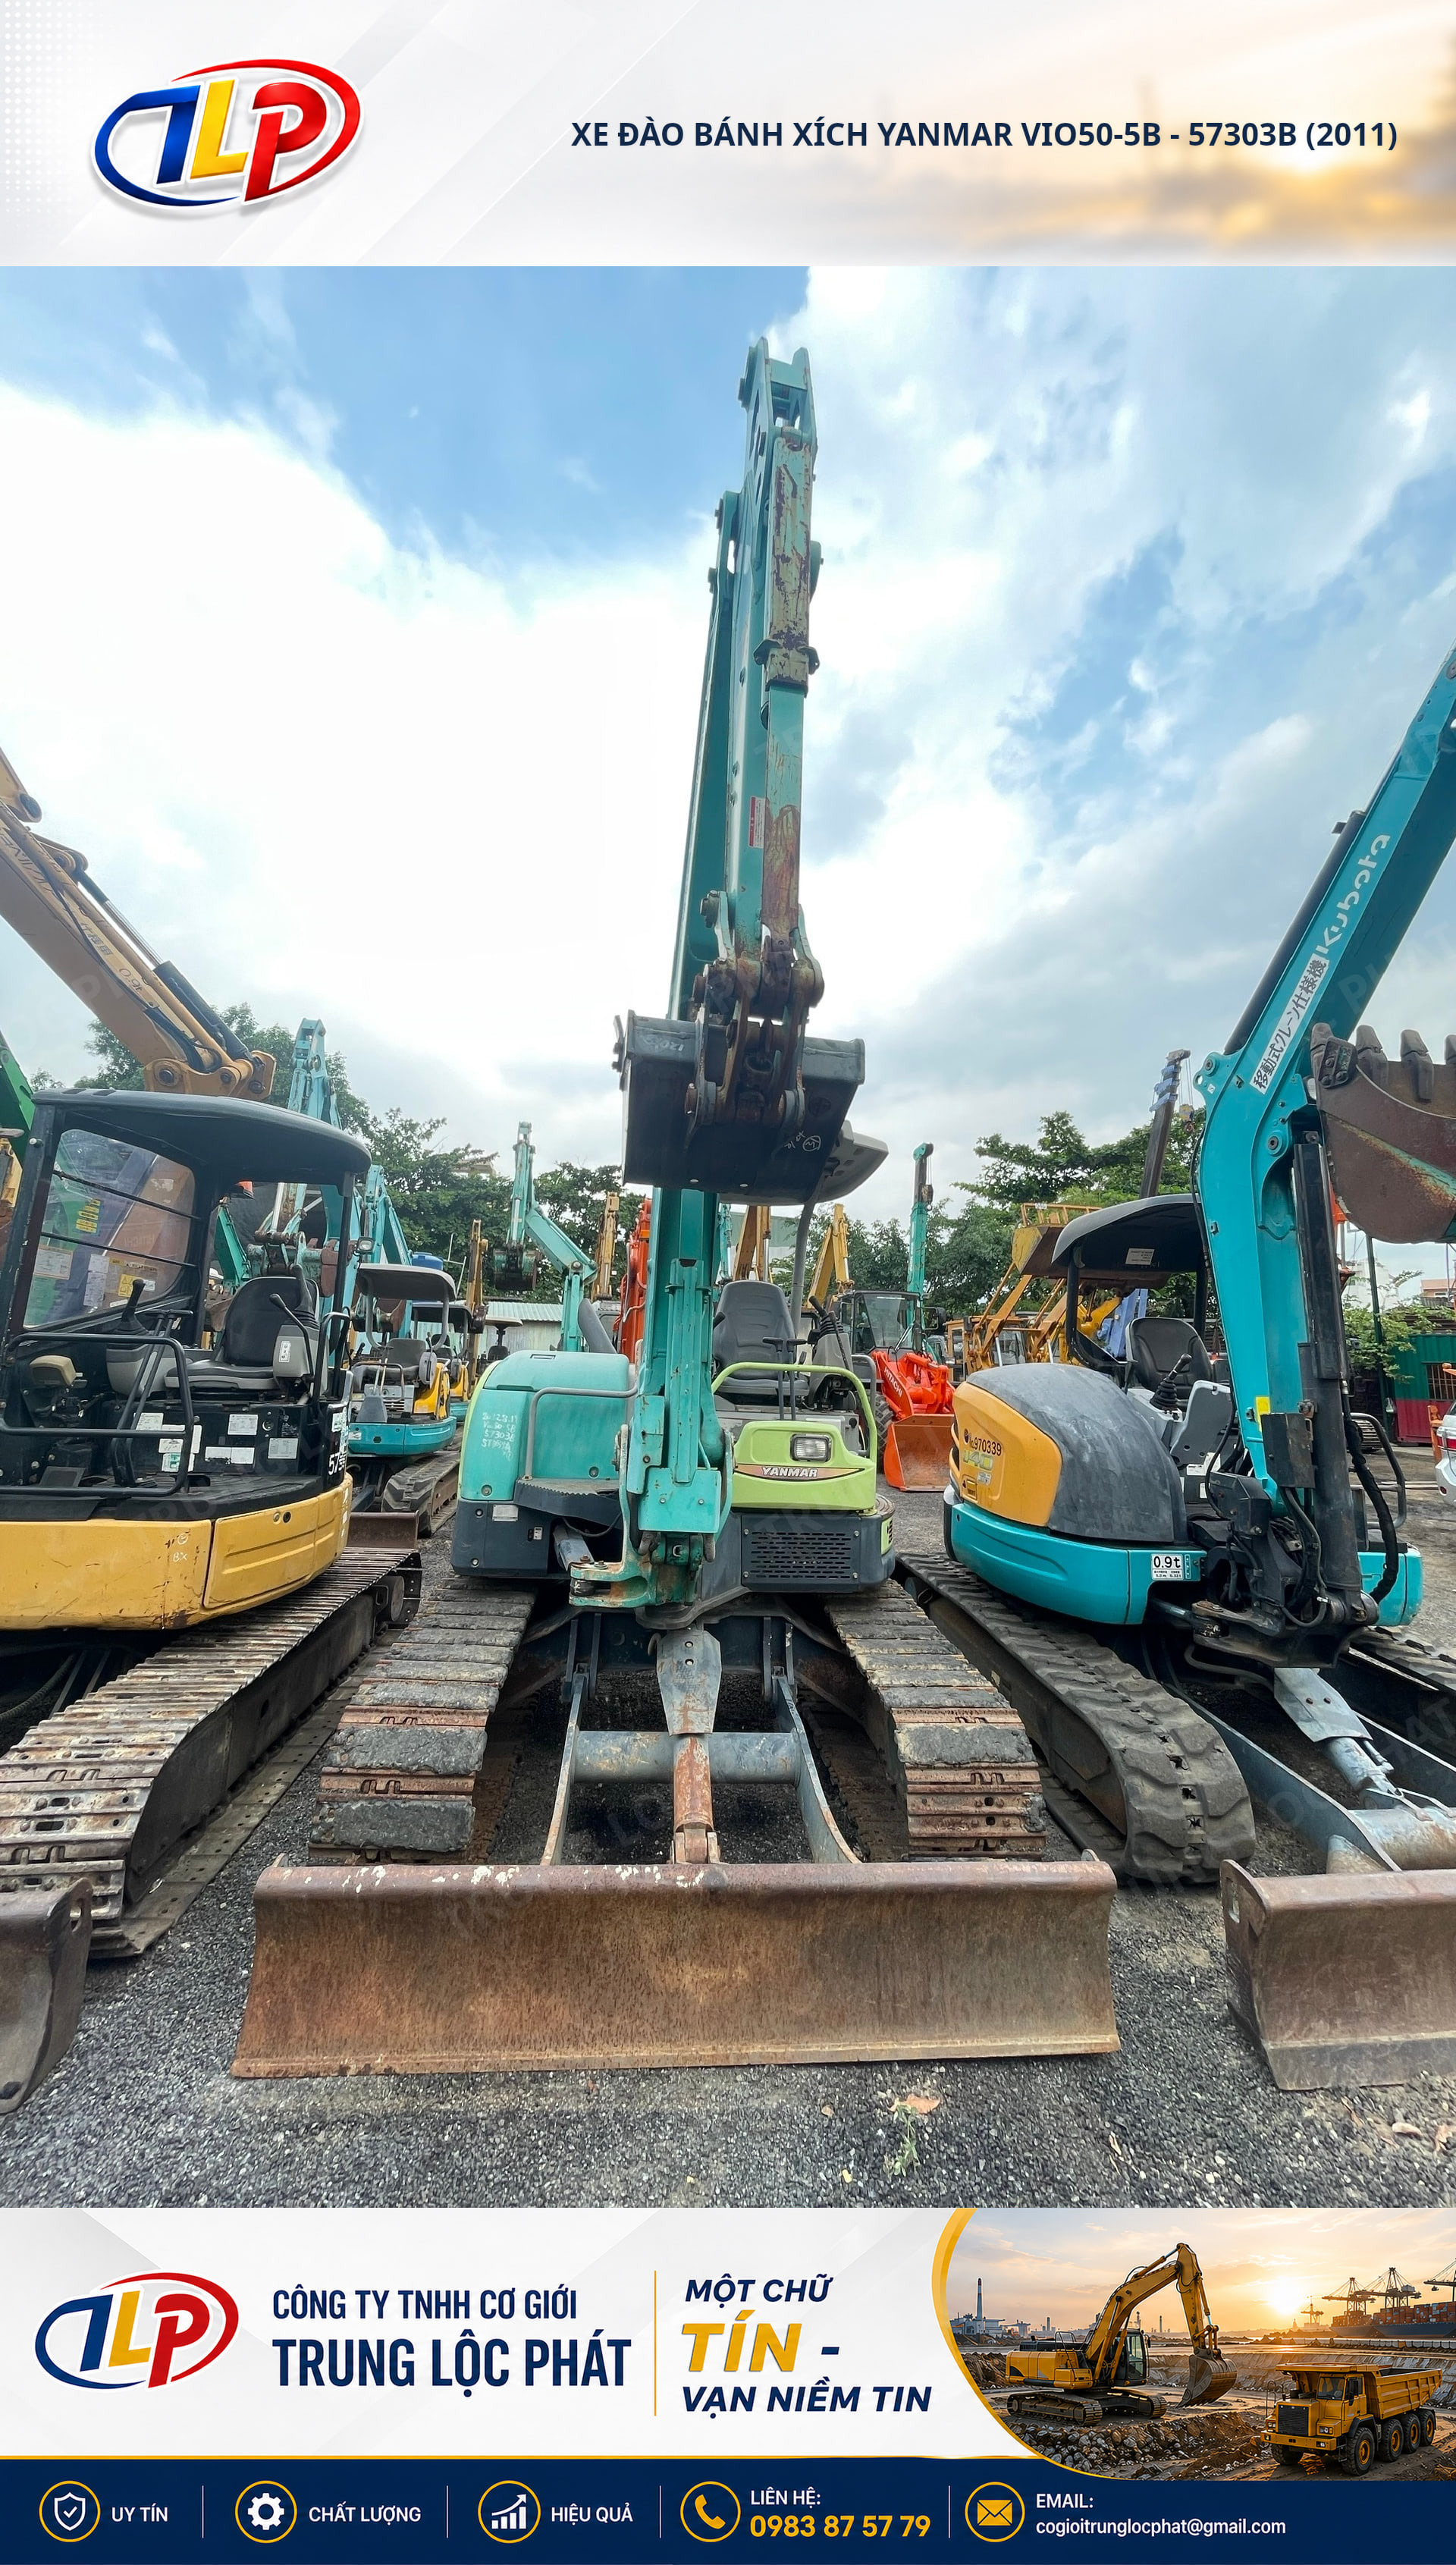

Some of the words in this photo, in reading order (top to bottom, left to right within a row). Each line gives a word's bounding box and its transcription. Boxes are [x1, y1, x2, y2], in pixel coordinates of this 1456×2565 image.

[1314, 834, 1391, 956] Kubota
[883, 1366, 903, 1397] HITACHI
[761, 1466, 818, 1477] YANMAR
[1153, 1556, 1181, 1568] 0.9t
